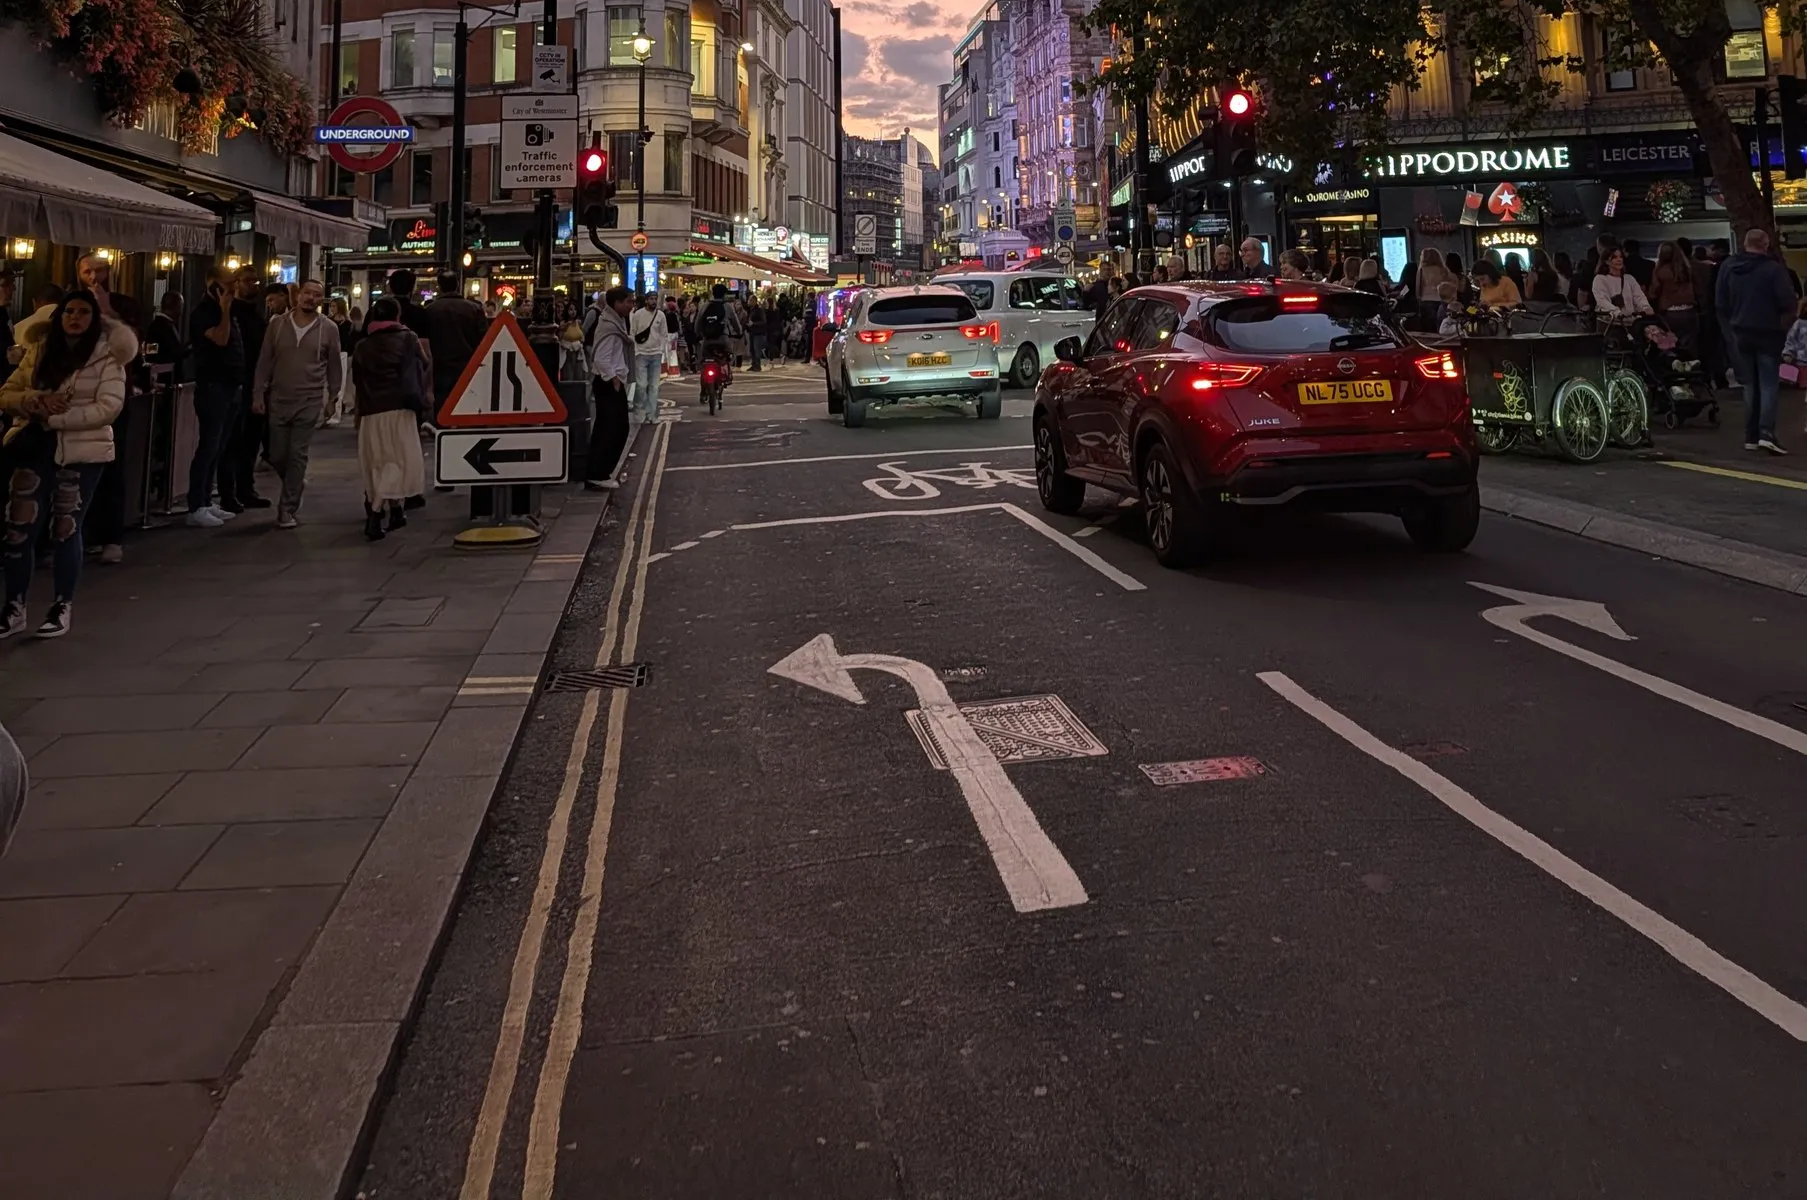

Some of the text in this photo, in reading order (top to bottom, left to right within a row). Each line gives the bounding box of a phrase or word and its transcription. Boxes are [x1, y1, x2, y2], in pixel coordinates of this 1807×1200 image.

[512, 108, 524, 116] City
[320, 129, 410, 140] UNDERGROUND
[522, 151, 558, 160] Traffic
[1602, 145, 1691, 162] LEICESTER
[505, 162, 574, 171] enforcement
[489, 240, 521, 248] RESTAURANT
[1481, 232, 1539, 247] CASINO
[931, 356, 948, 364] HZC
[1305, 382, 1385, 401] NL75 UCG
[1248, 418, 1281, 426] JUKE
